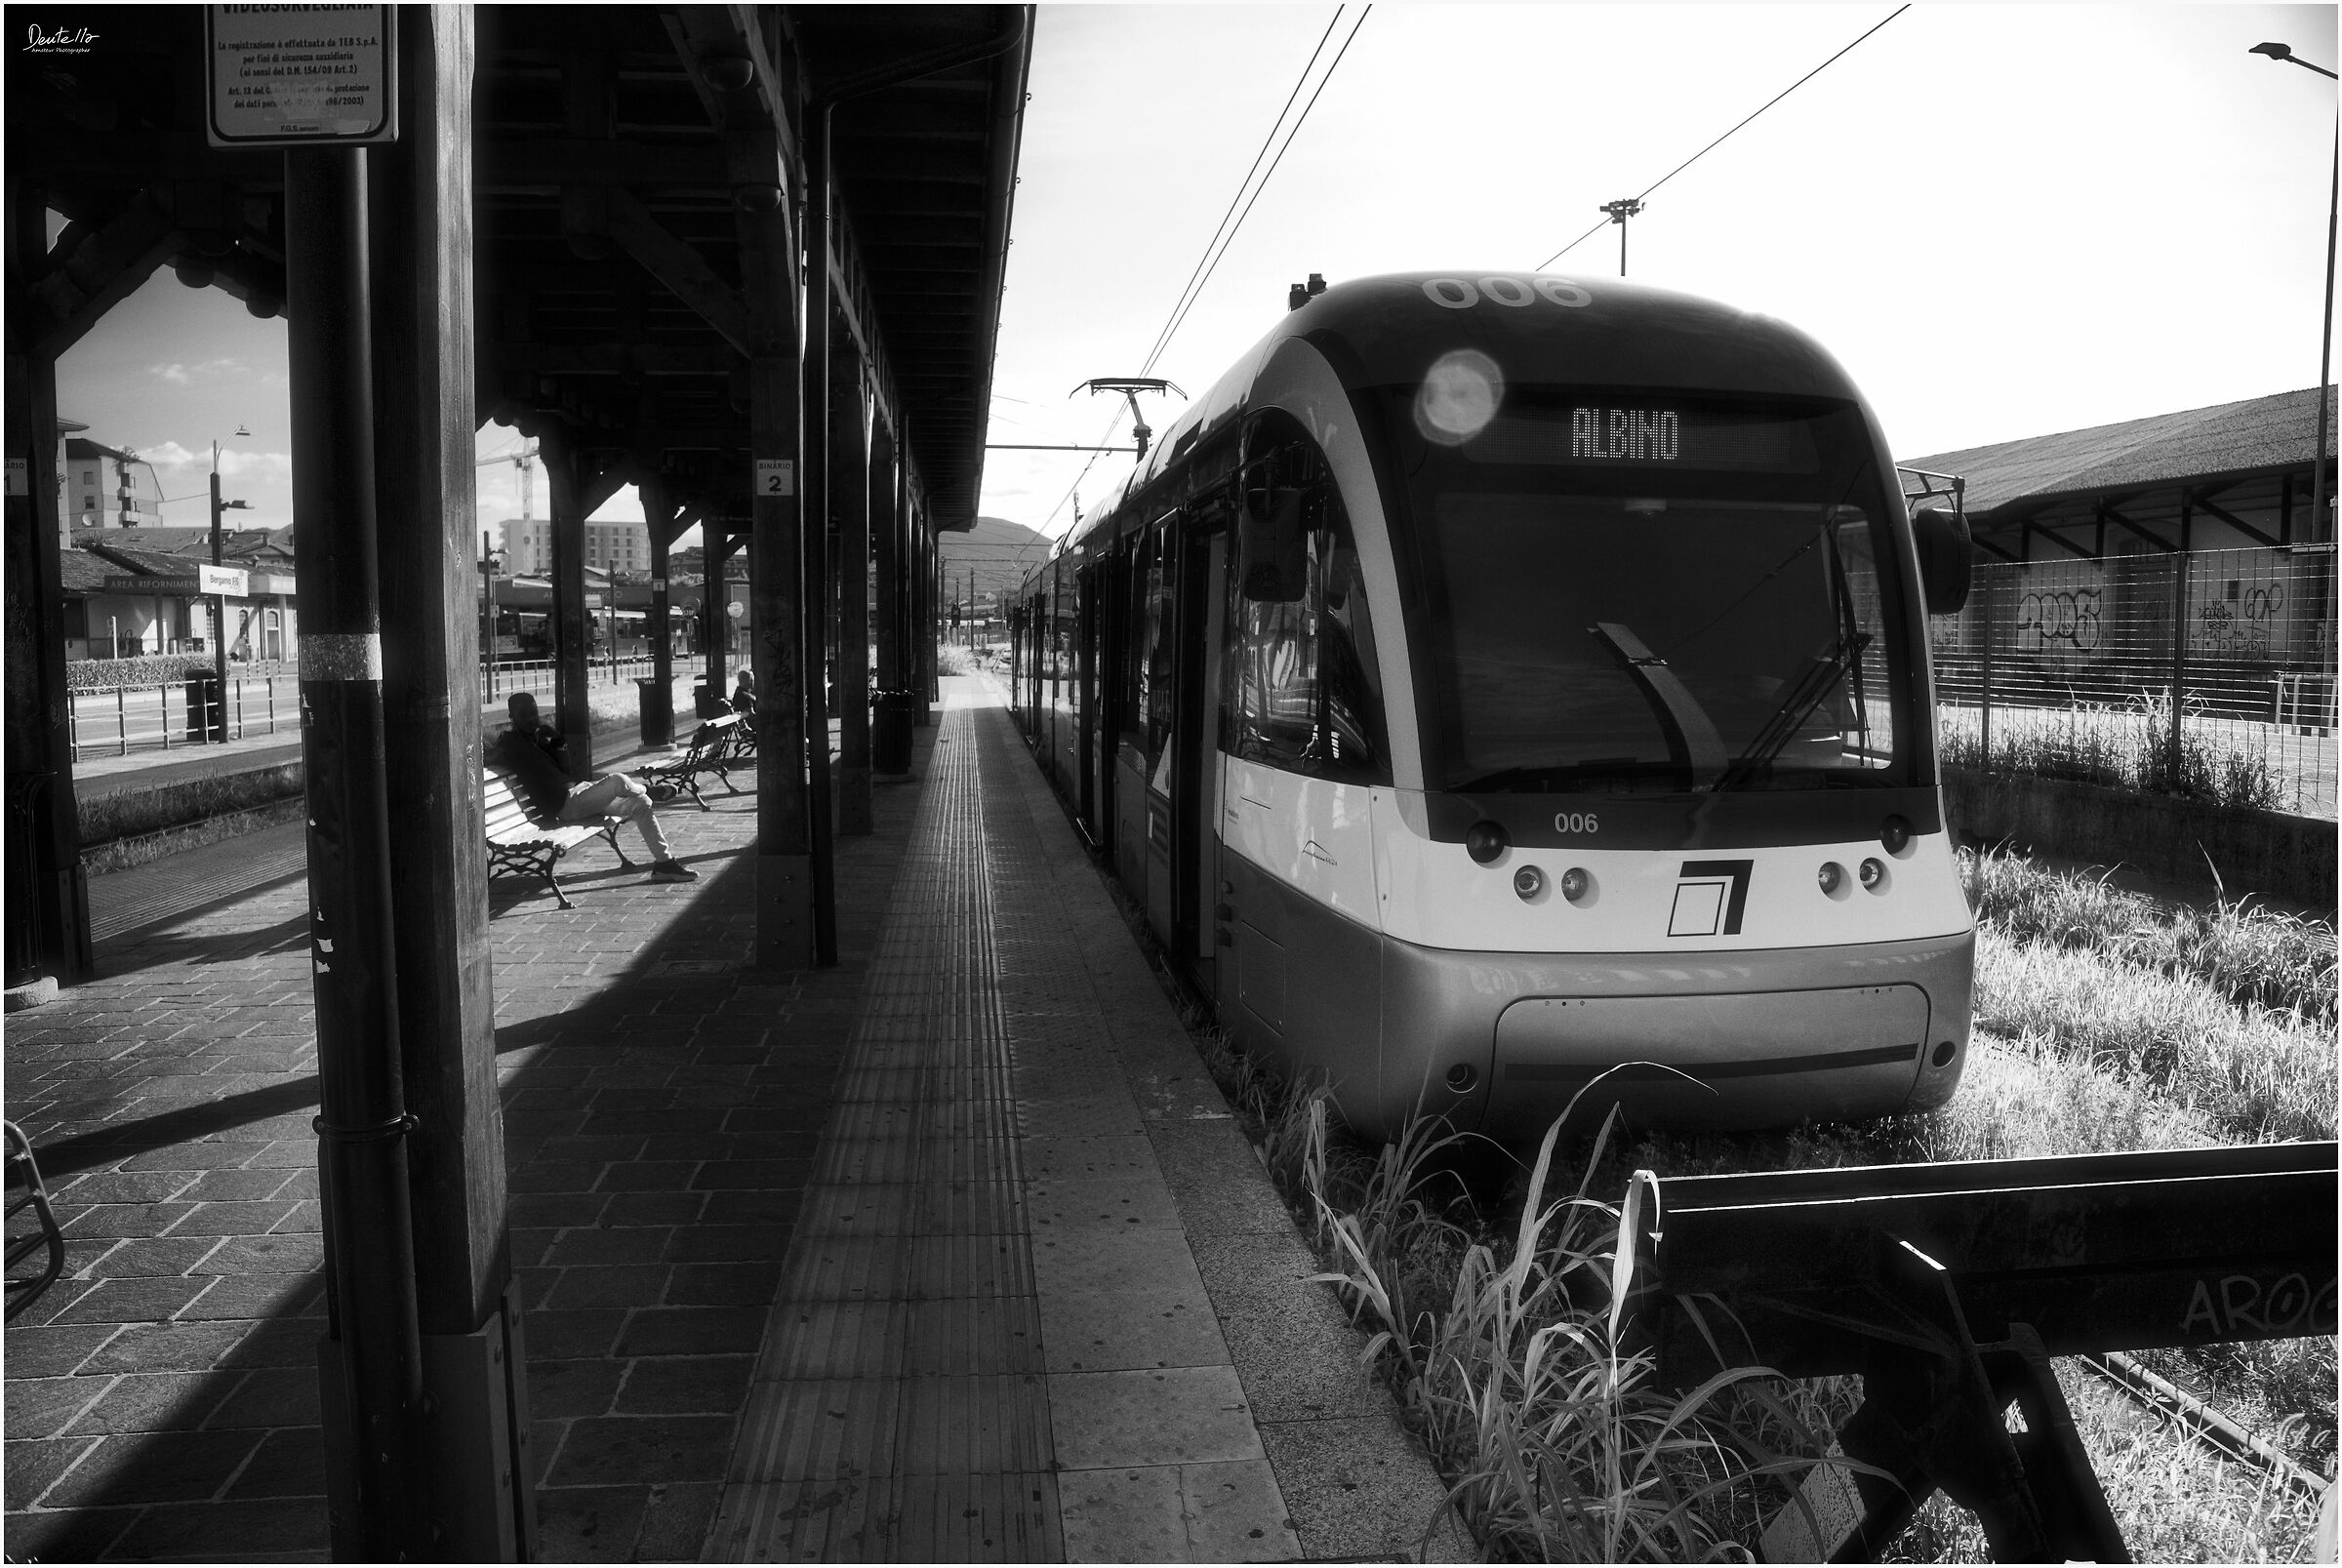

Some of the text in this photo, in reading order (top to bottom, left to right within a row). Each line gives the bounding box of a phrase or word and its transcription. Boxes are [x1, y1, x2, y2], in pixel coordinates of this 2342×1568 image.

[219, 41, 225, 50] La
[228, 41, 274, 51] registrazione
[285, 39, 324, 48] effettuata
[339, 37, 354, 47] TEB
[356, 36, 378, 47] S.p.A.
[243, 56, 255, 64] per
[257, 54, 269, 62] fini
[272, 54, 279, 62] di
[240, 67, 251, 78] (ai
[253, 66, 271, 76] sensi
[273, 66, 284, 75] del
[303, 64, 332, 75] 154/09
[244, 86, 251, 95] 13
[254, 86, 264, 95] del
[335, 84, 370, 94] protezione
[234, 100, 245, 108] dei
[1422, 276, 1593, 308] 006
[1572, 407, 1678, 460] ALBINO
[769, 475, 782, 492] 2
[111, 580, 200, 589] AREA RIFORNIMEN
[210, 574, 232, 586] Bergamo
[1555, 813, 1600, 833] 006
